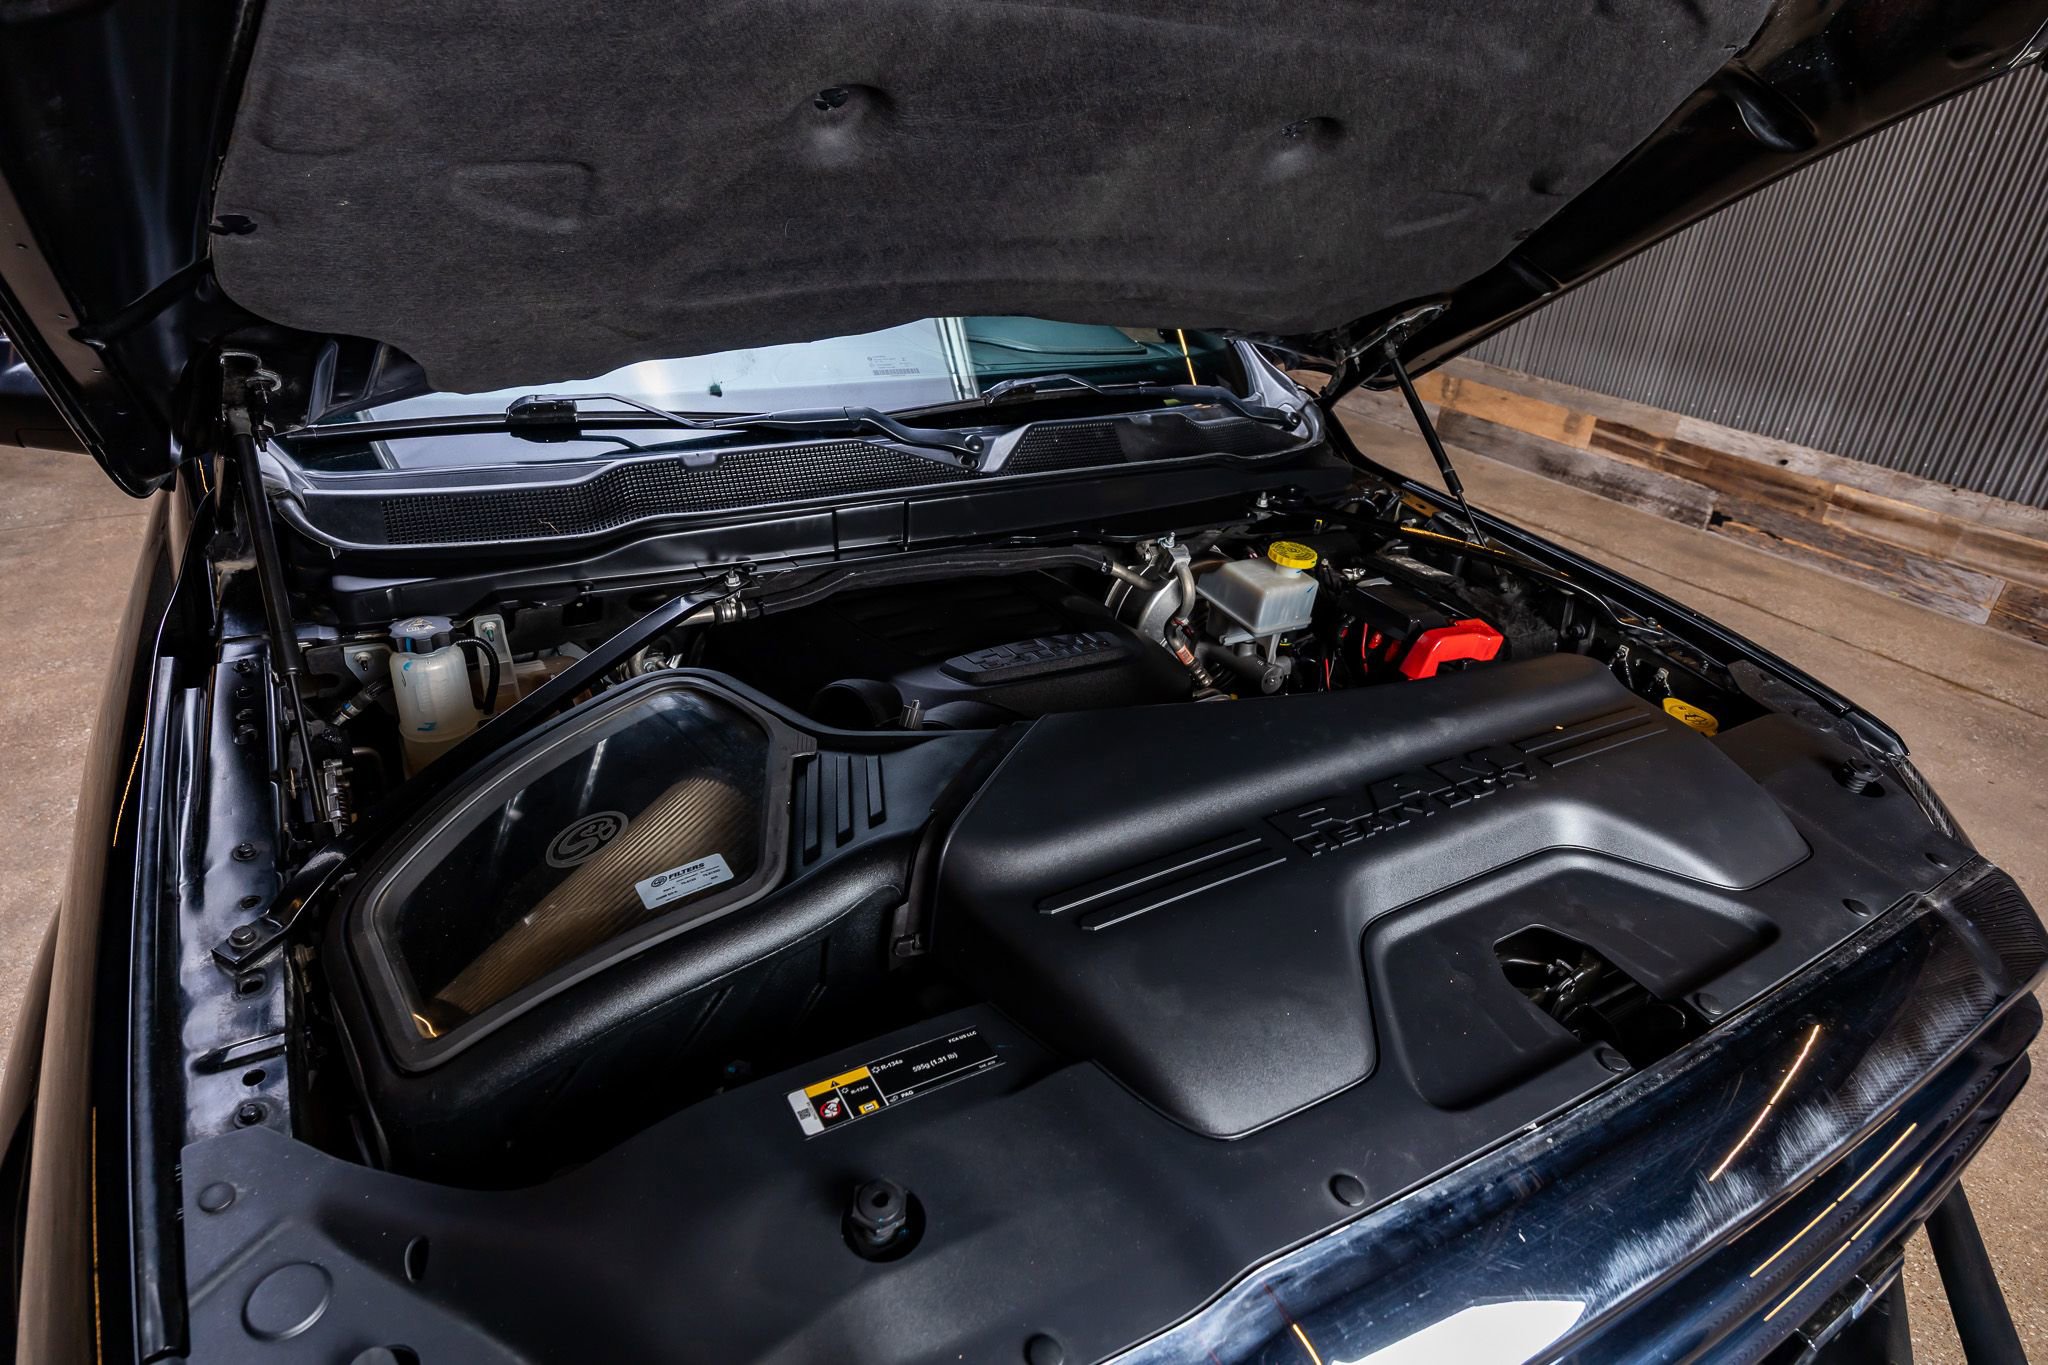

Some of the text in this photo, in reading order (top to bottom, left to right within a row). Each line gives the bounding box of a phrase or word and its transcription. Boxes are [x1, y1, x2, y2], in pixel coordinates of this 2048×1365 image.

[1263, 746, 1524, 842] RAM
[668, 862, 705, 879] FILTERS
[948, 1036, 960, 1044] FCA
[966, 1030, 978, 1038] LLC
[880, 1058, 903, 1071] R-134a
[912, 1051, 958, 1073] 595g (1.31 lb)
[900, 1089, 914, 1099] PAG
